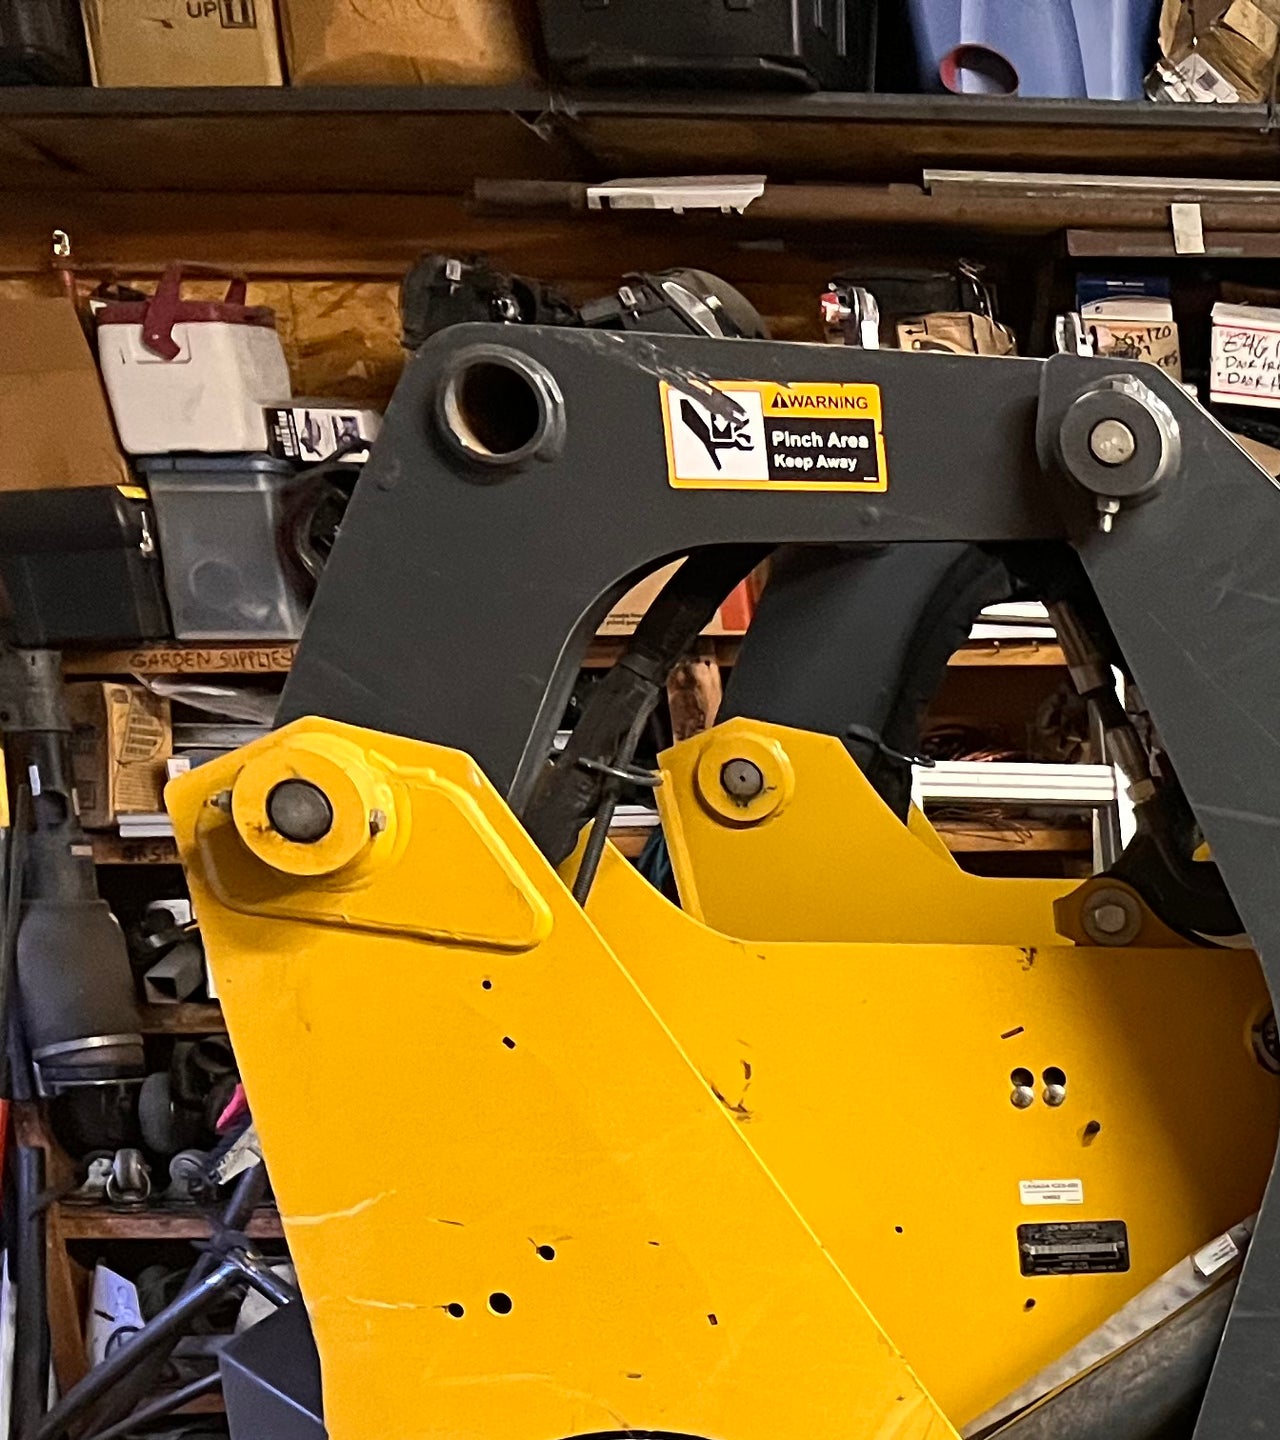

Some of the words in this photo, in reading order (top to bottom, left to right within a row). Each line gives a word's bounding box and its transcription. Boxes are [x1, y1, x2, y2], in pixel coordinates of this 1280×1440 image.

[186, 0, 217, 18] UP
[789, 394, 868, 409] WARNING
[771, 431, 823, 448] Pinch
[827, 432, 869, 449] Area
[774, 455, 813, 470] Keep
[816, 455, 857, 472] Away
[129, 650, 211, 669] GARDEN
